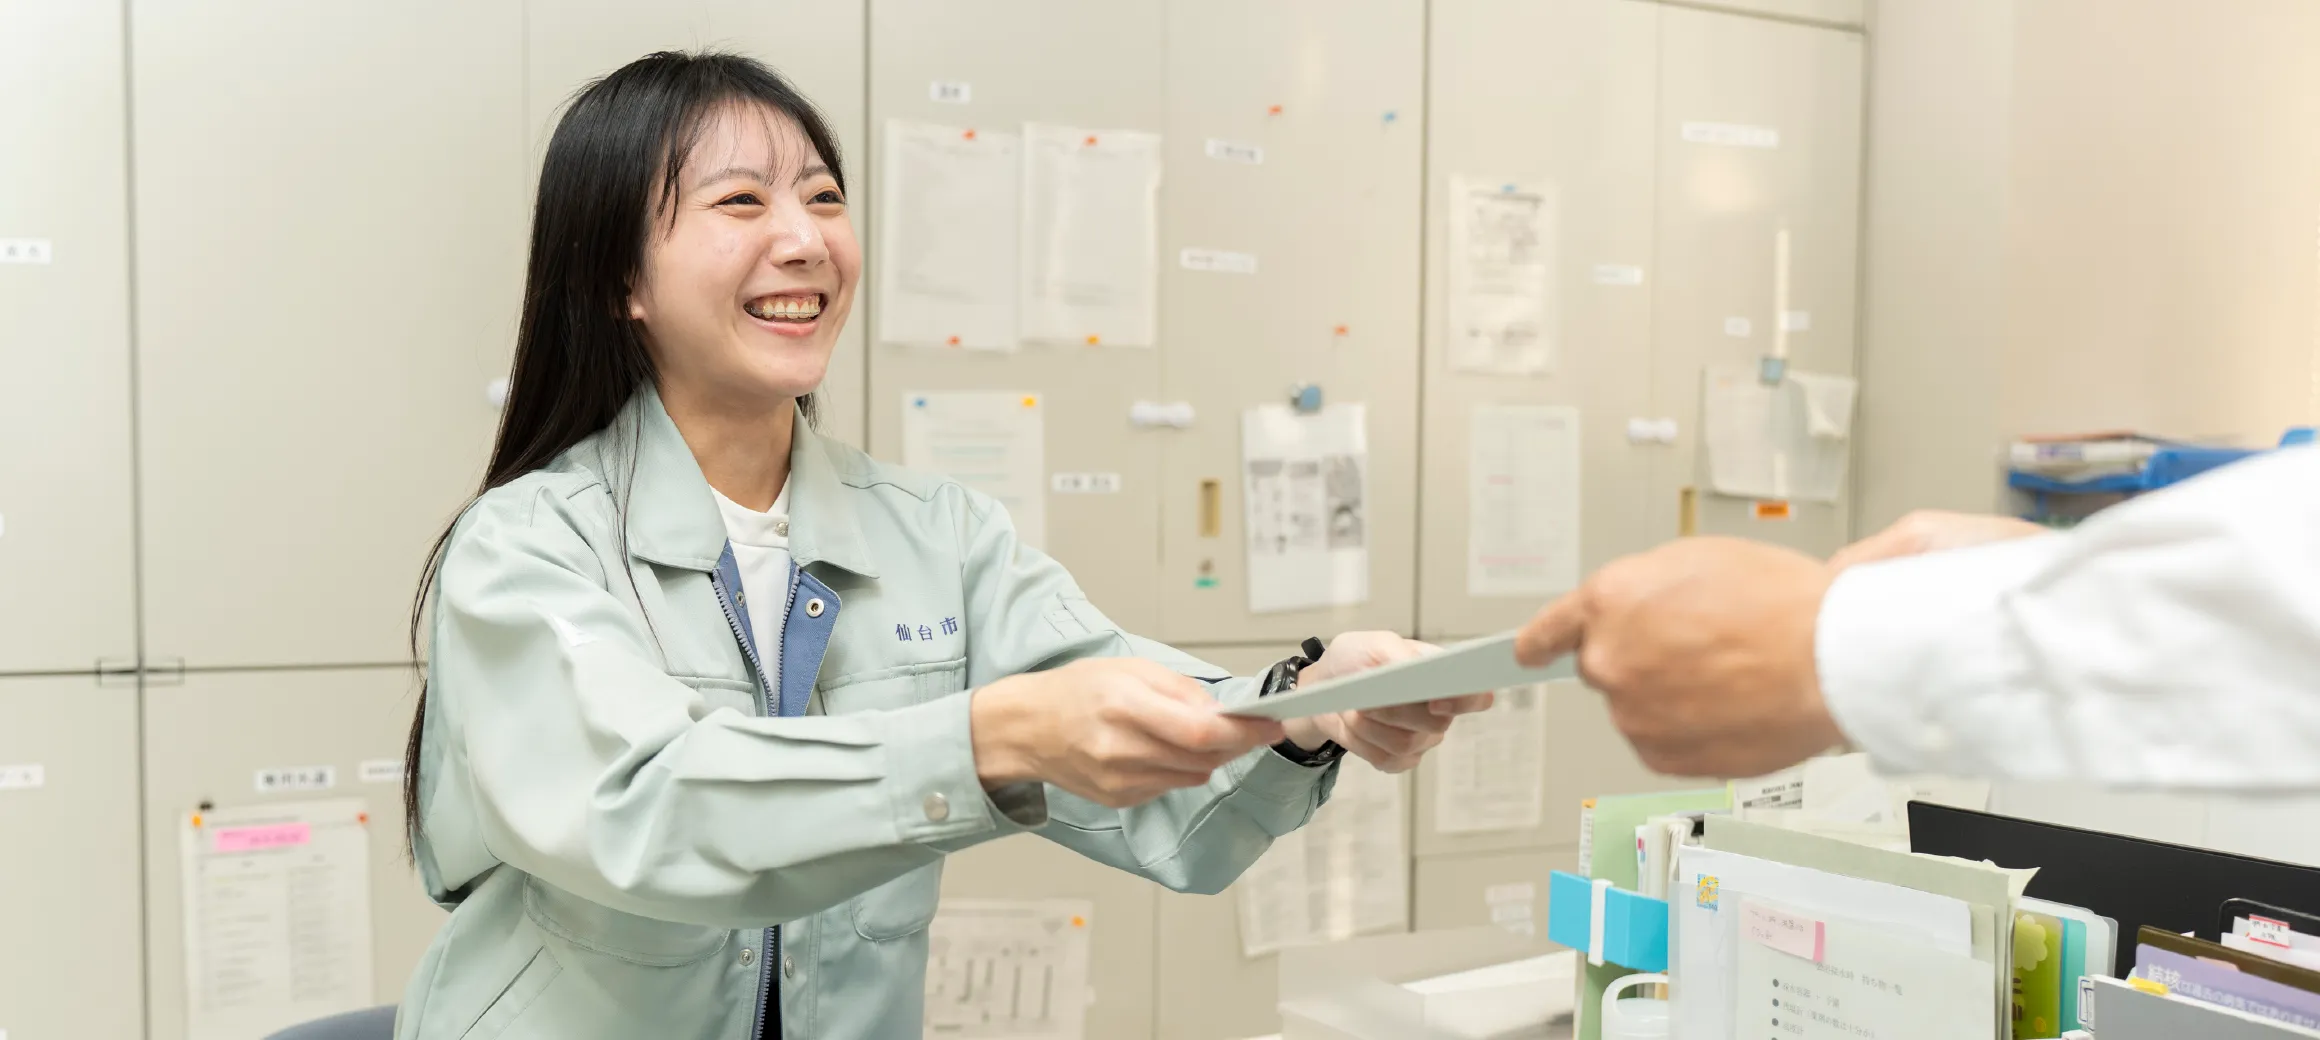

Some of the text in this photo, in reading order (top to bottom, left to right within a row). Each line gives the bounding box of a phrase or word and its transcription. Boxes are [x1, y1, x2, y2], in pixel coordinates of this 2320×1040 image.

[895, 617, 958, 641] 仙台市
[2147, 963, 2320, 1031] 結核は過去の病気ではありませ
